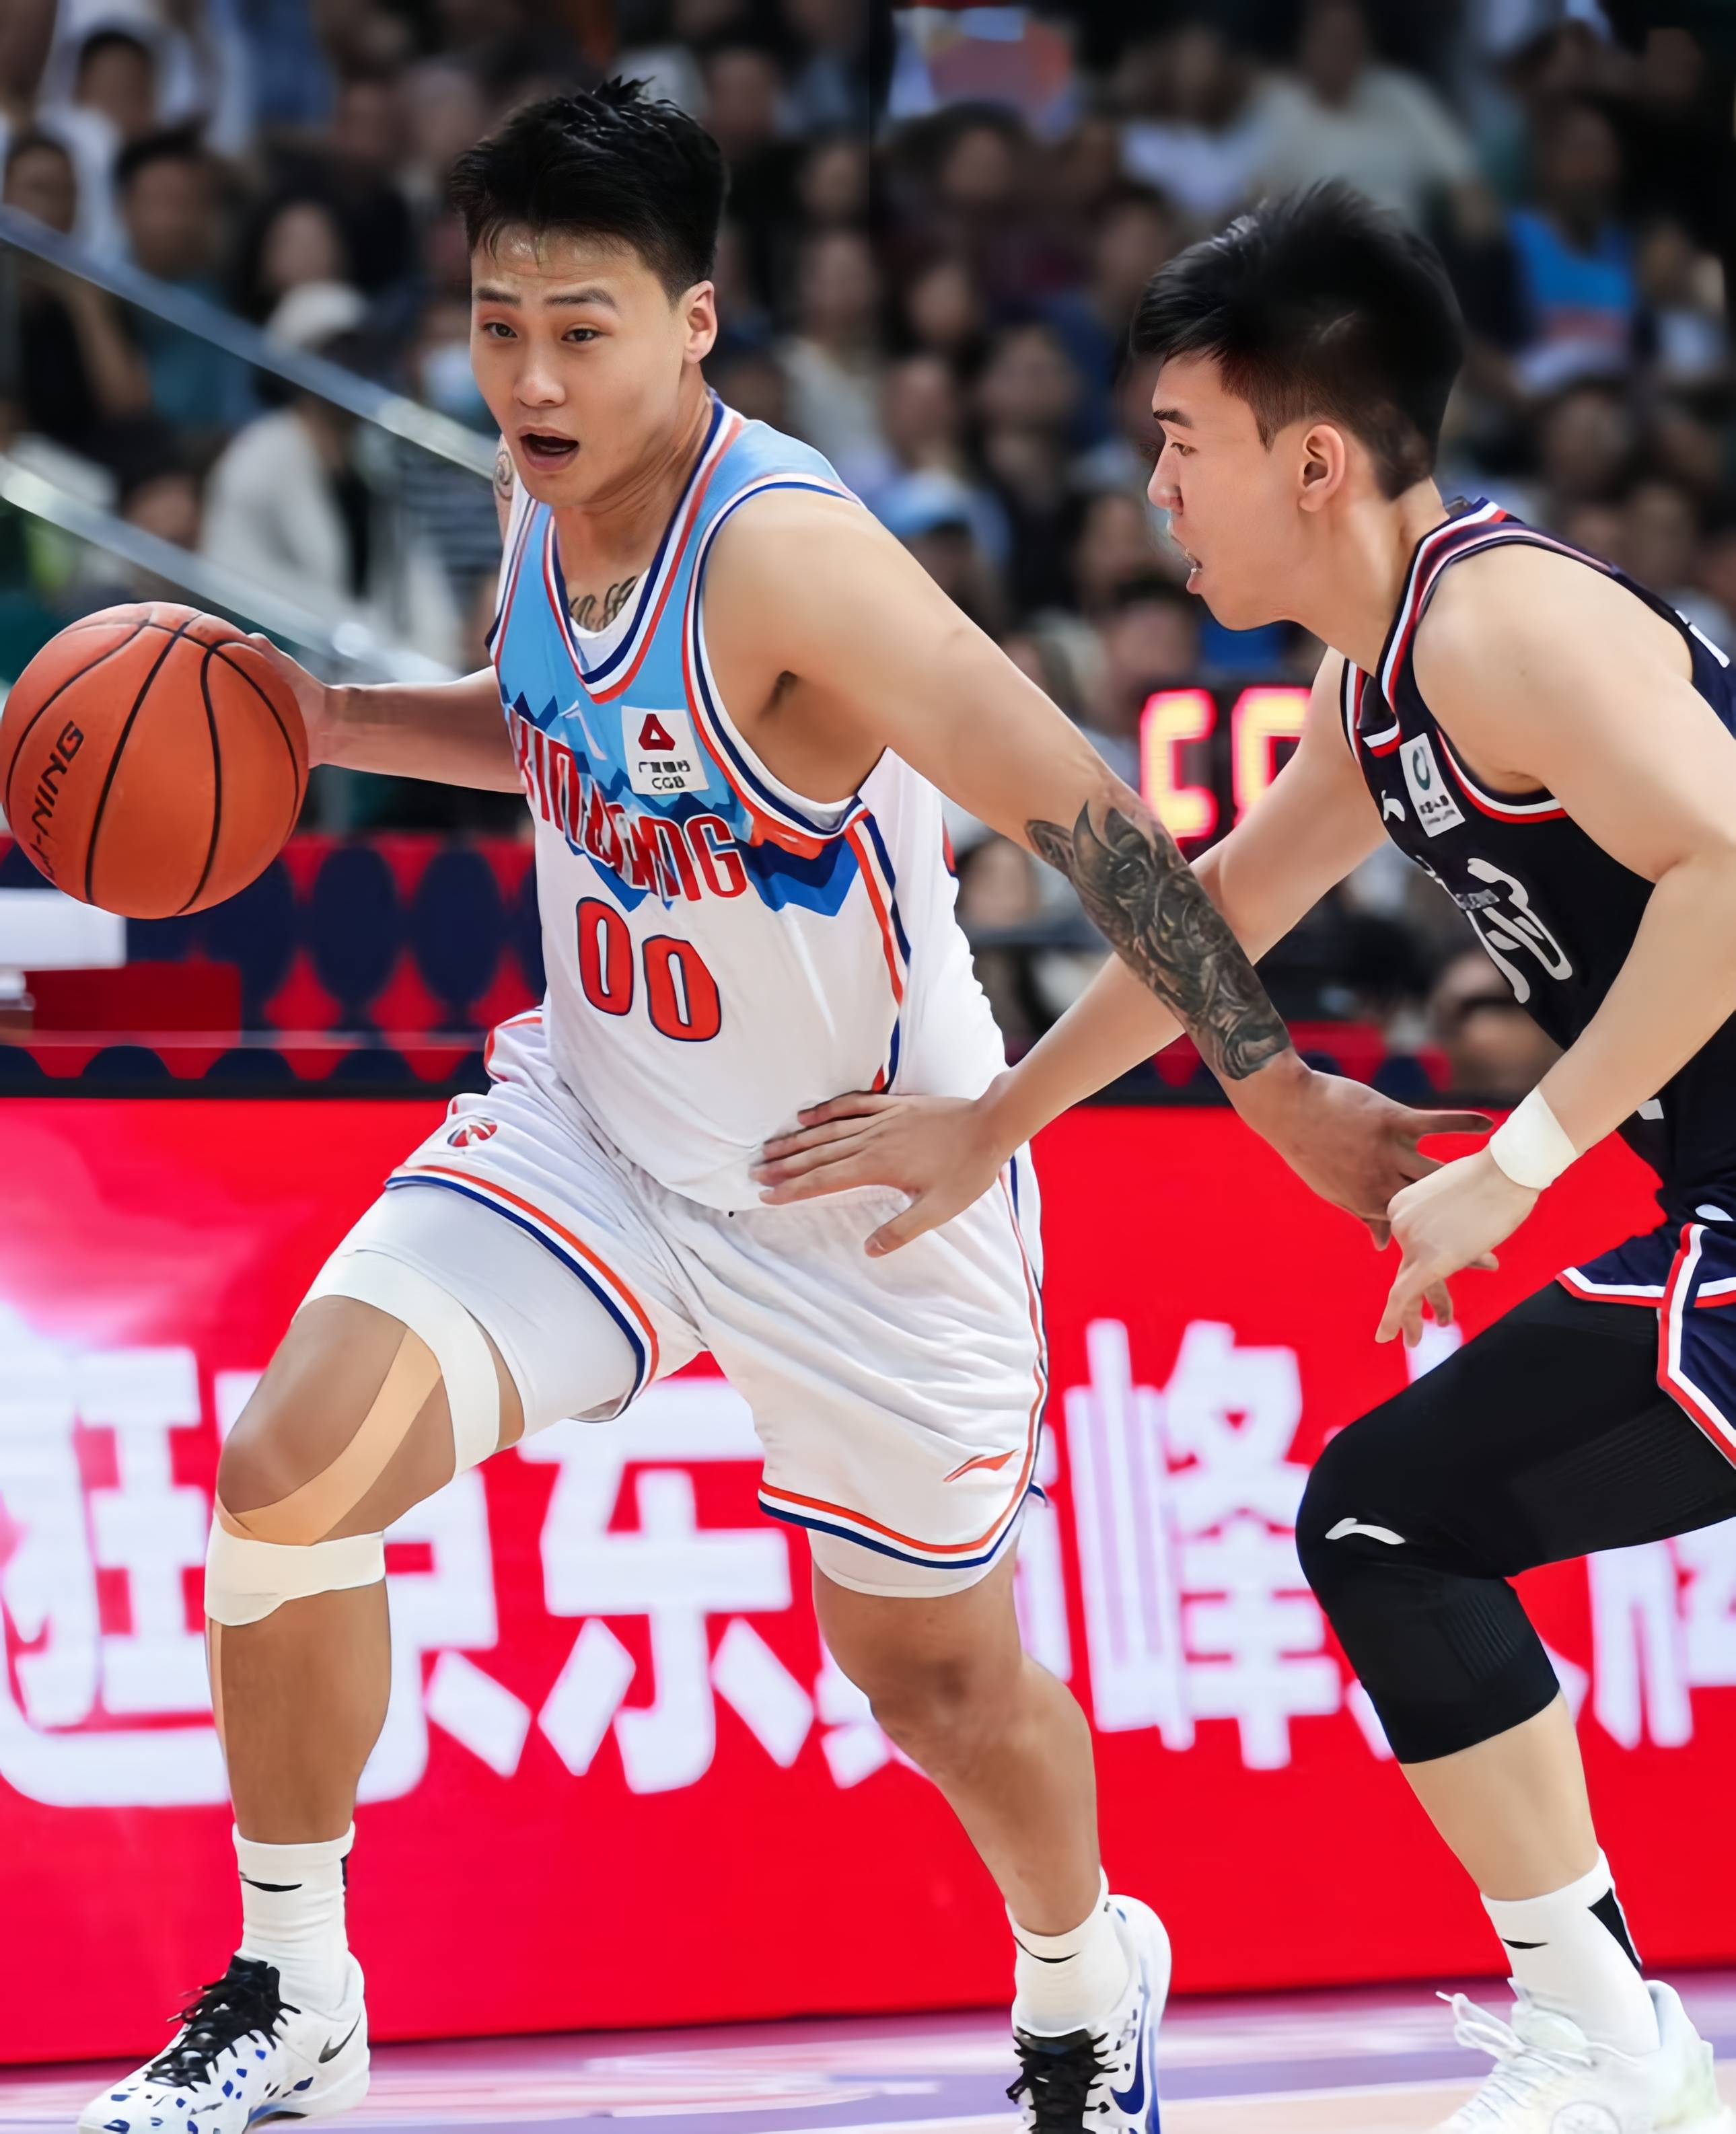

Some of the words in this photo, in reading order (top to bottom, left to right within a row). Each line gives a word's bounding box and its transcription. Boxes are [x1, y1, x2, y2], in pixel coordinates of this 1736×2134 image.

[651, 775, 686, 790] CGB
[576, 895, 722, 1042] 00
[0, 1315, 1736, 1810] 逛京东峰
